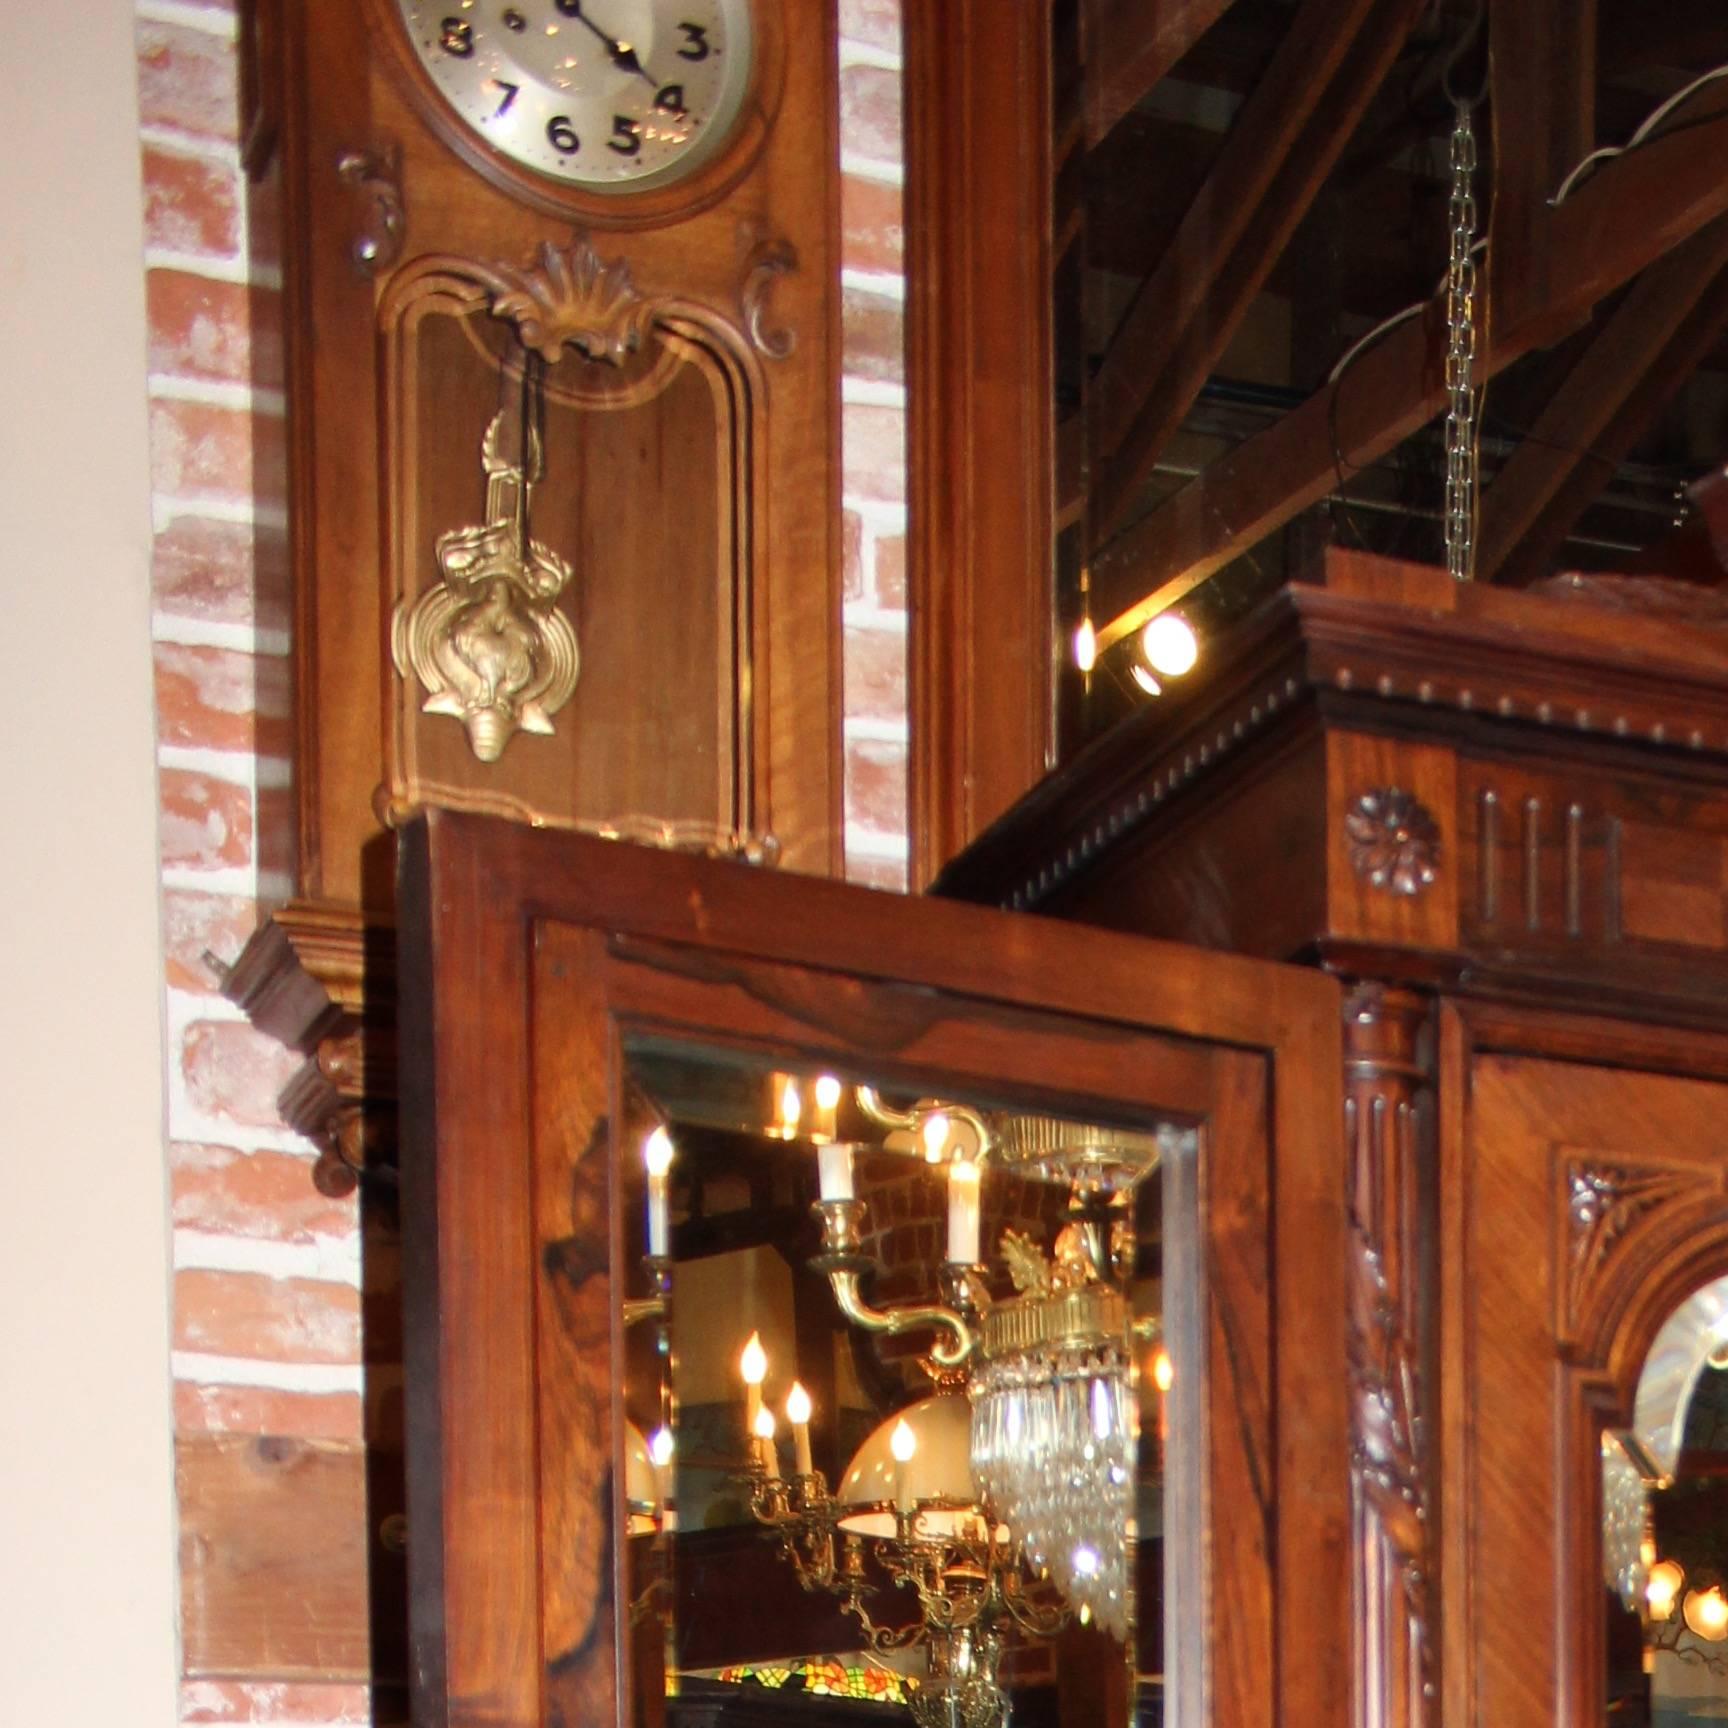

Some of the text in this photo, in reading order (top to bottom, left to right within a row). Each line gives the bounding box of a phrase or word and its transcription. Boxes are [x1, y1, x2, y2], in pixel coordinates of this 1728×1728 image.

[440, 17, 475, 59] 8
[677, 22, 709, 61] 3
[493, 79, 520, 118] 7
[653, 85, 690, 122] 4
[546, 115, 580, 155] 6
[606, 114, 641, 156] 5
